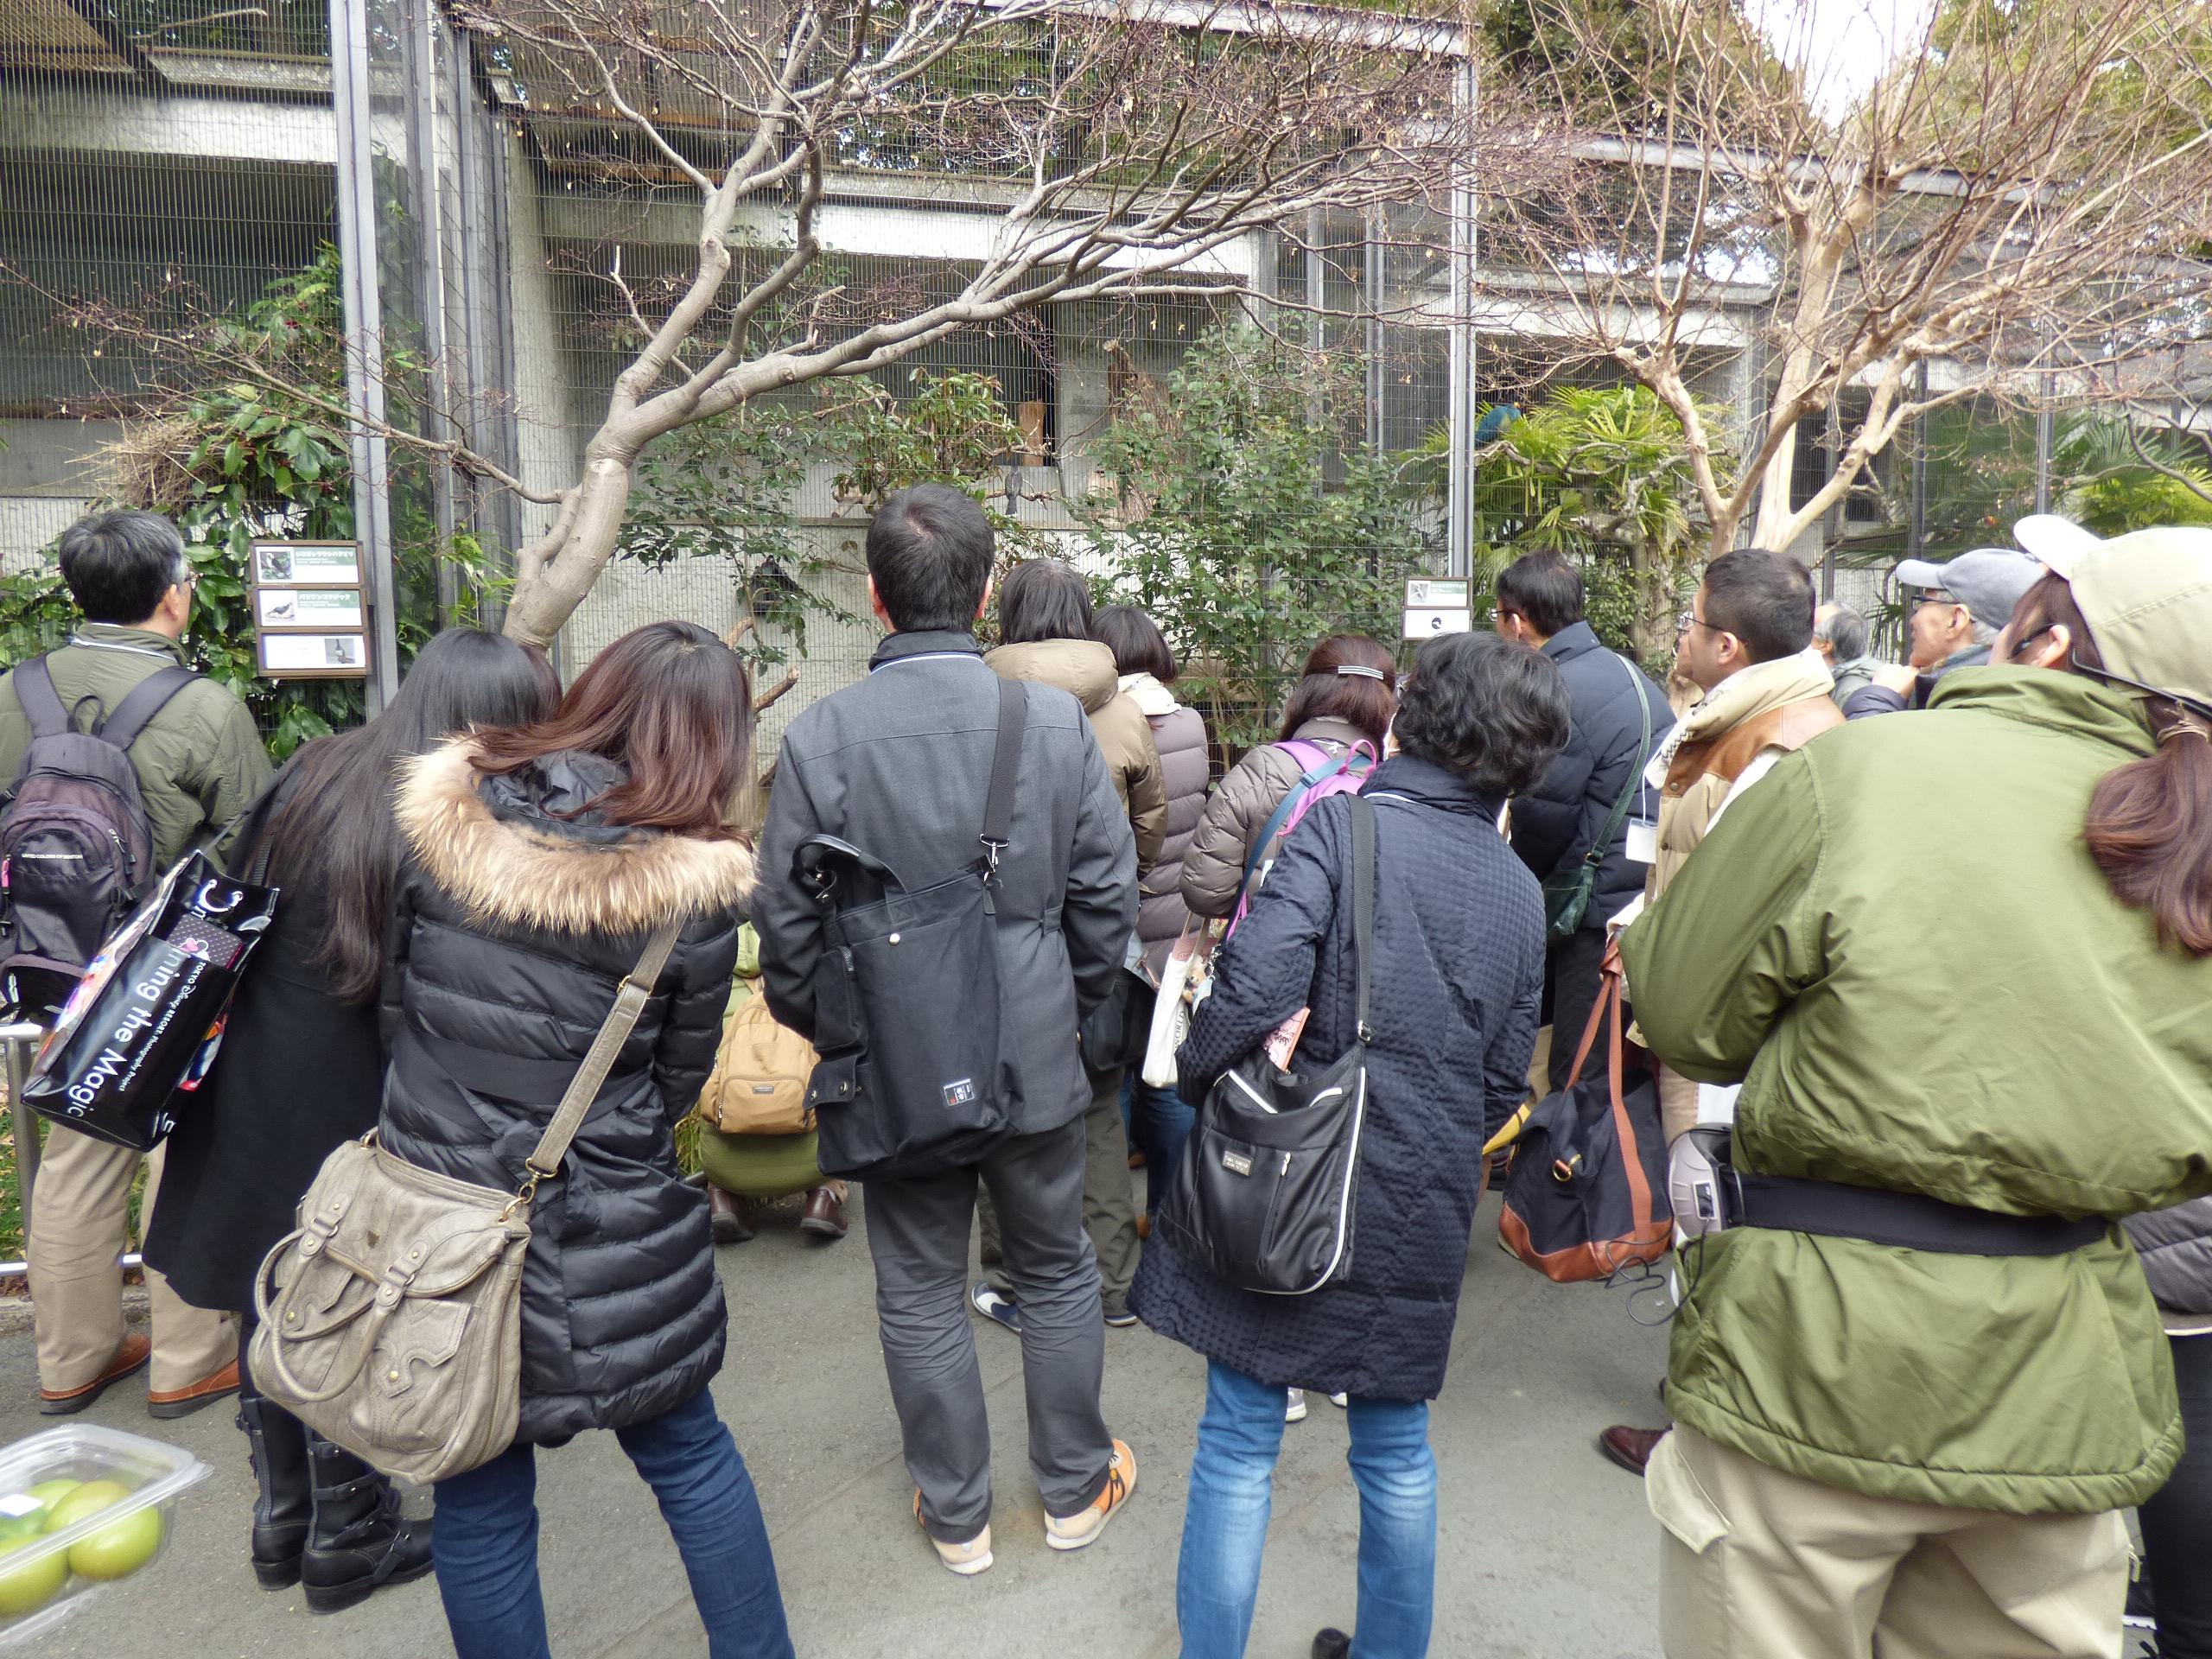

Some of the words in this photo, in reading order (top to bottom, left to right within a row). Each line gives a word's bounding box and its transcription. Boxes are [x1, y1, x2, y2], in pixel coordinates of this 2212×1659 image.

[187, 960, 207, 985] TOKYO
[169, 984, 196, 1013] Disney
[114, 1007, 153, 1044] the
[157, 1007, 177, 1037] RESORT
[130, 1034, 158, 1071] Photography
[67, 1047, 128, 1117] Magic
[119, 1068, 137, 1092] Project
